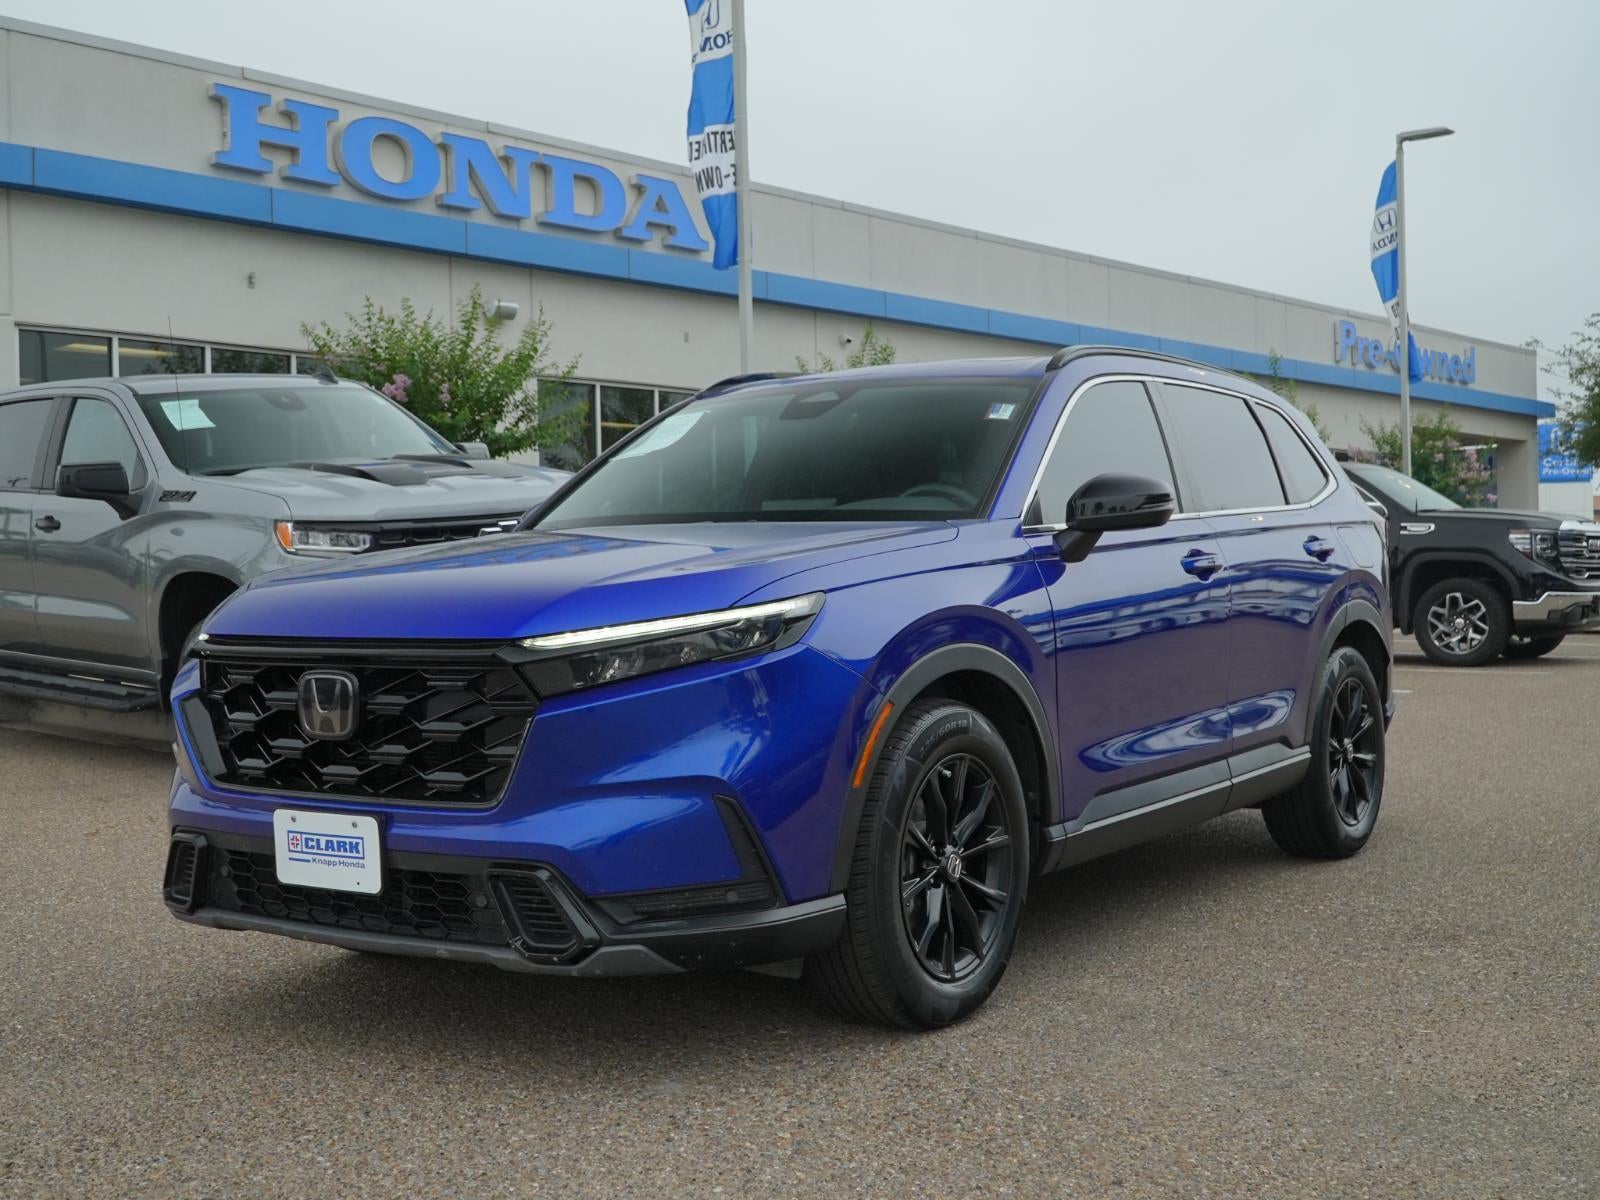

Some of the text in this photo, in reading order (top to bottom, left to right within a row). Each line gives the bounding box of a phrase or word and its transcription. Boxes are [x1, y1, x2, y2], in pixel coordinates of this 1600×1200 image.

[208, 82, 709, 251] HONDA
[1335, 320, 1475, 385] Pre-wned
[304, 837, 361, 855] CLARK
[311, 857, 366, 869] Knapp Honda
